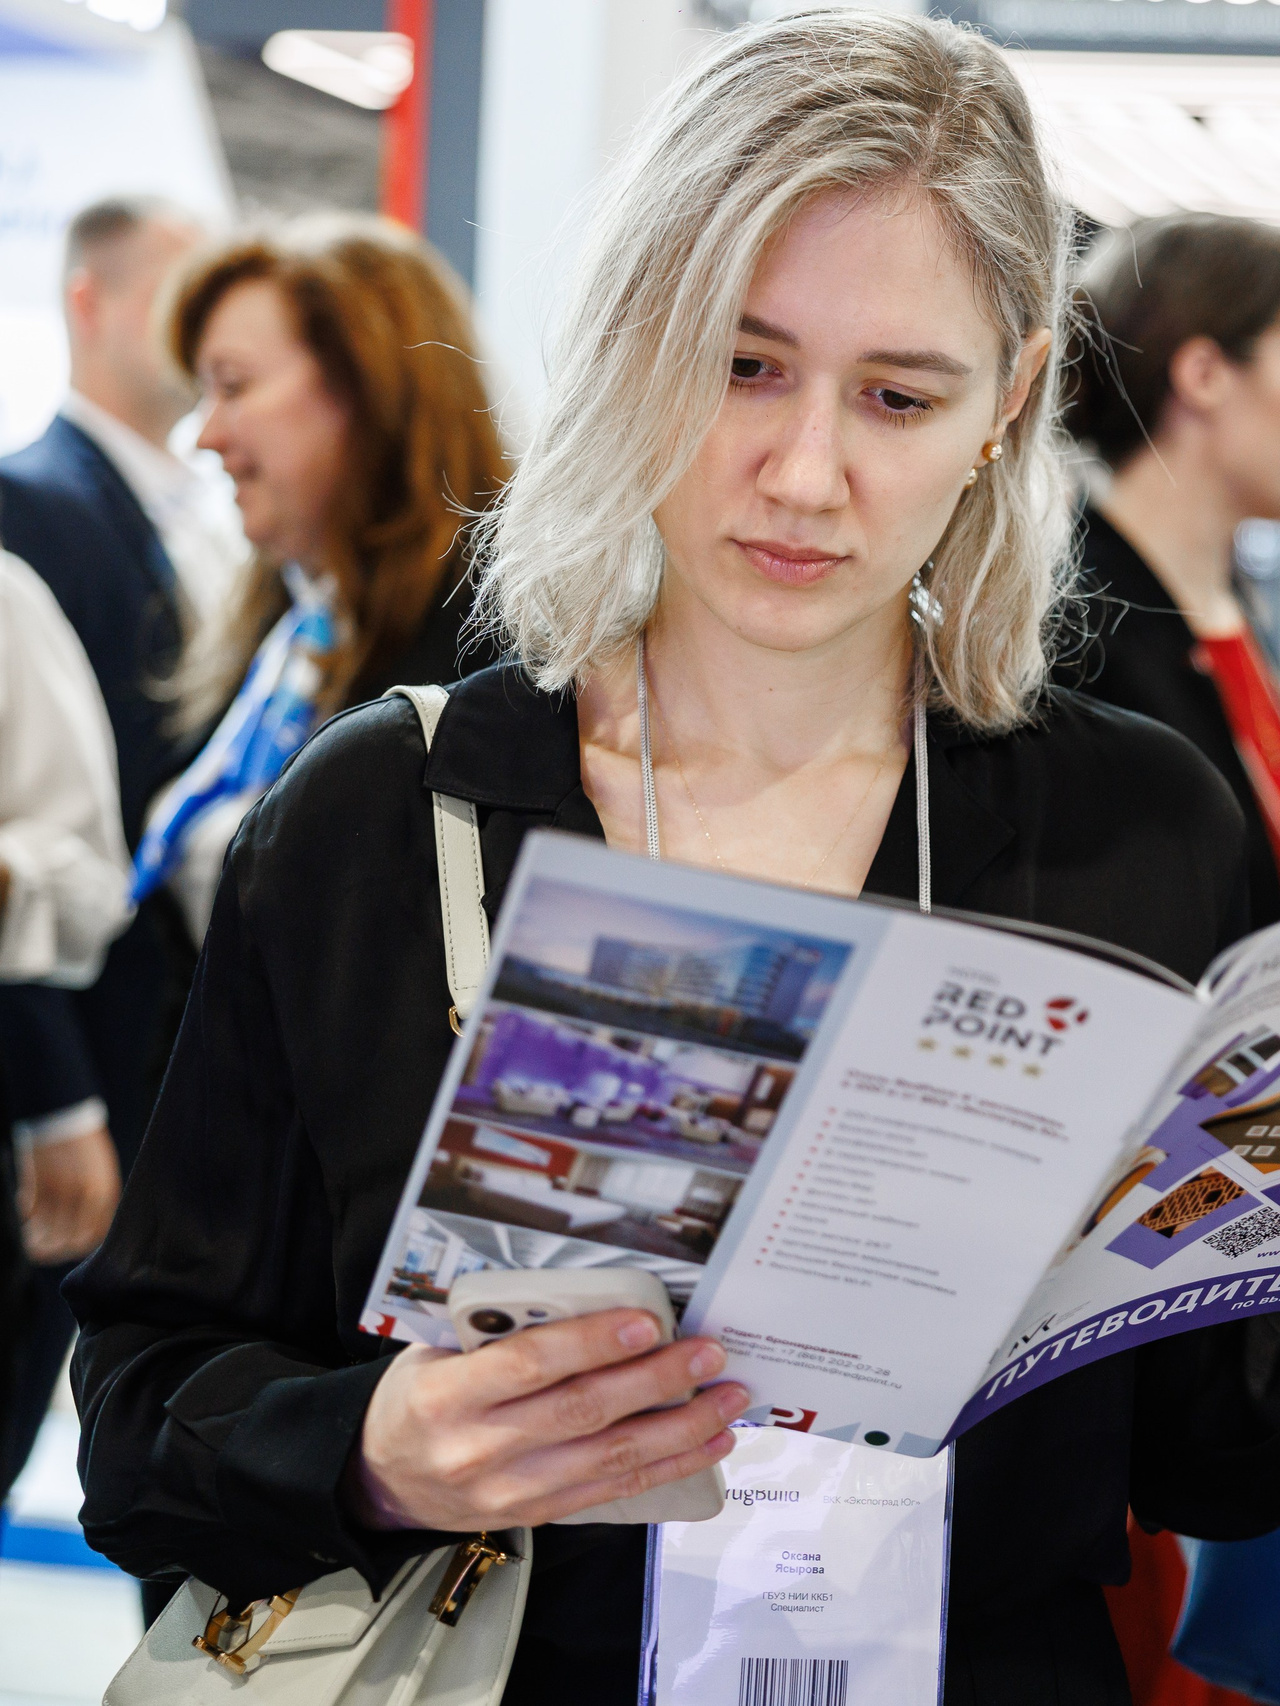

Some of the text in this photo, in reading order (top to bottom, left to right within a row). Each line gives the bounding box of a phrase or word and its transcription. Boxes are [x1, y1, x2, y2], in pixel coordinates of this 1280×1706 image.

[934, 980, 1027, 1020] RED
[921, 1004, 1063, 1056] POINT
[1230, 1300, 1255, 1311] по
[756, 1353, 902, 1390] reservations@redpoint.ru
[828, 1356, 891, 1378] 202-07-28
[823, 1495, 920, 1507] ВКК «Экспоград Юг»
[781, 1550, 821, 1562] Оксана
[775, 1563, 825, 1576] Ясырова
[762, 1591, 834, 1602] ГБУЗ НИИ ККБ1
[770, 1602, 825, 1613] Специалист
